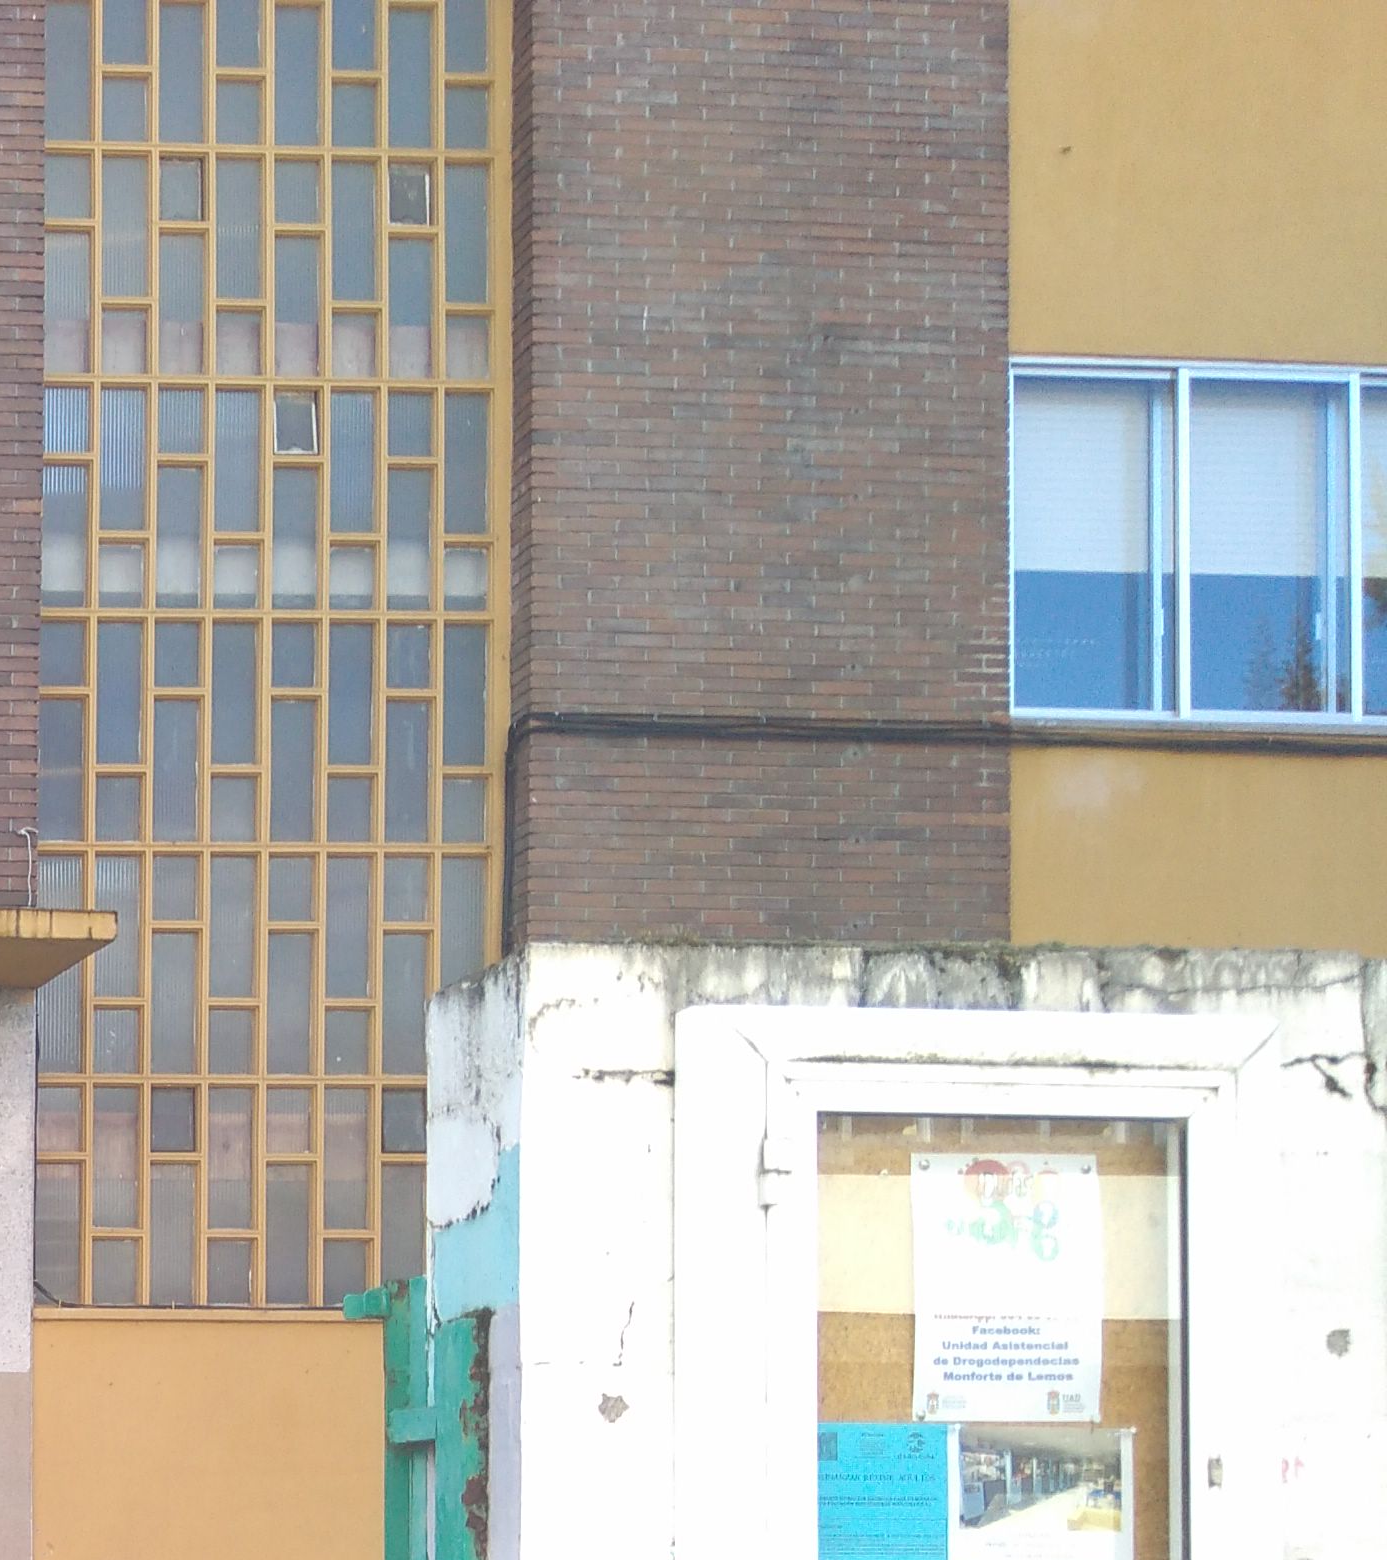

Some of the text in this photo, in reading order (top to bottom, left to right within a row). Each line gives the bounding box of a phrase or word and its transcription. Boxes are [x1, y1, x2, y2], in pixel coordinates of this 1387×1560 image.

[972, 1325, 1041, 1336] Facebook:
[942, 1341, 1069, 1351] Unidad Asistencial
[933, 1356, 949, 1366] de
[943, 1371, 1074, 1381] Monforte de Lemos
